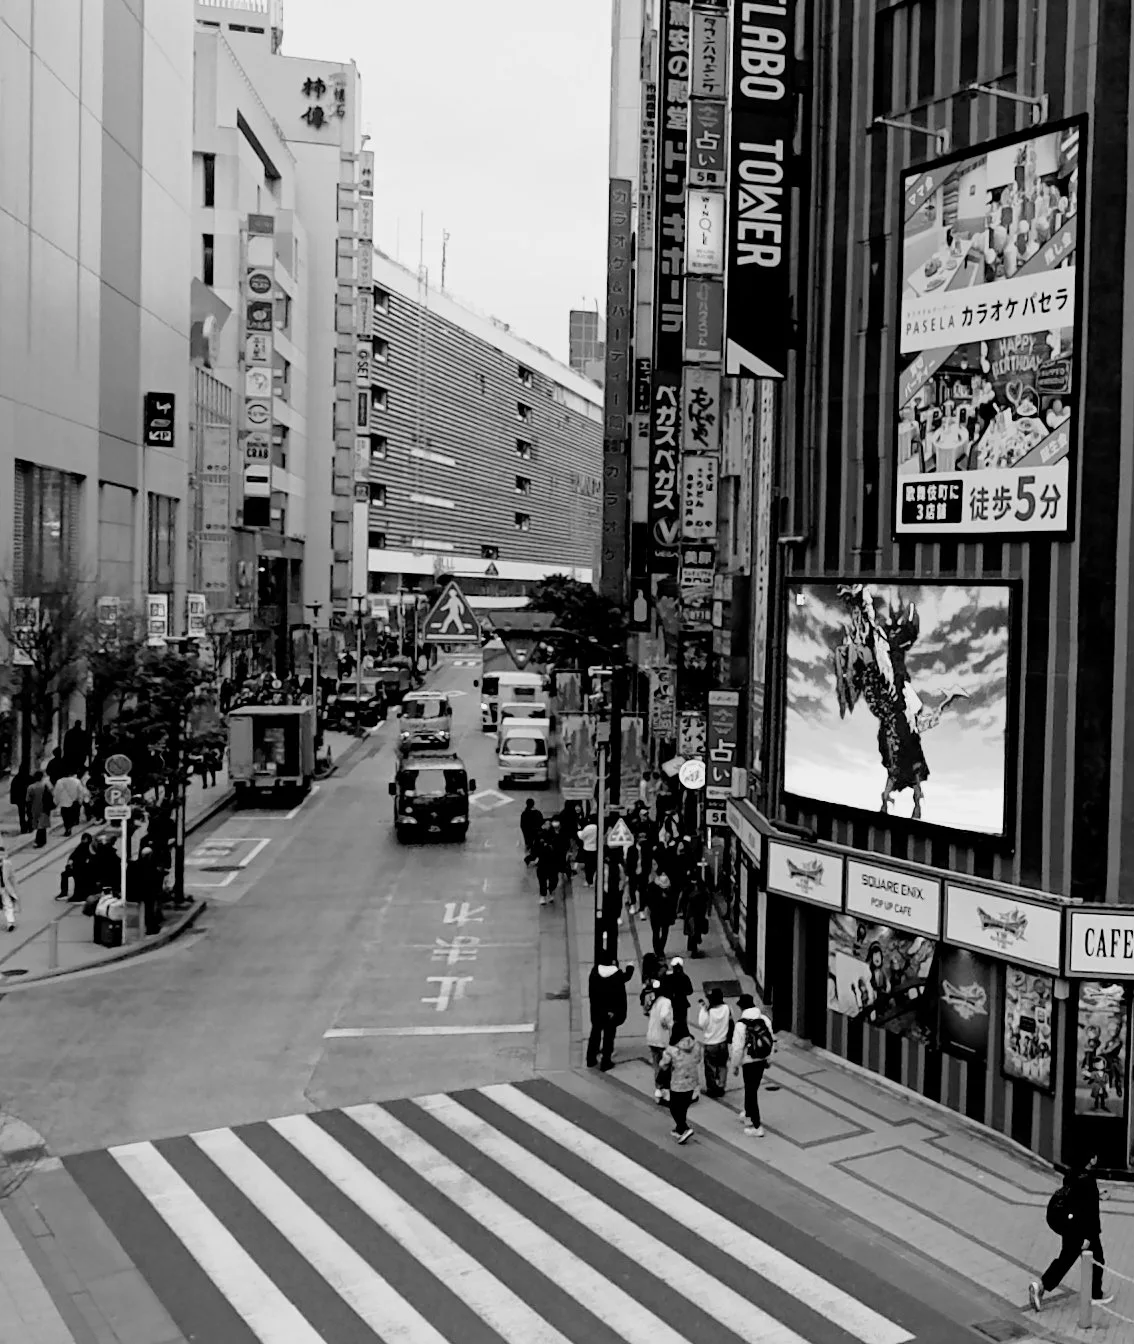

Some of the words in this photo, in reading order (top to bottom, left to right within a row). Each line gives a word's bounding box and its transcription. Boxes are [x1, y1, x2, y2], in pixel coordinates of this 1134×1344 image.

[696, 131, 721, 166] 占い
[736, 140, 784, 268] TOWER
[962, 289, 1069, 327] カラオケパセラ
[906, 315, 955, 336] PASELA
[1000, 335, 1037, 356] HAPPY
[970, 475, 1061, 522] 徒歩5分
[709, 739, 736, 782] 占い
[861, 873, 899, 896] SQUARE
[871, 897, 883, 908] POP
[894, 904, 912, 917] CAFE
[1084, 928, 1134, 959] CAFE
